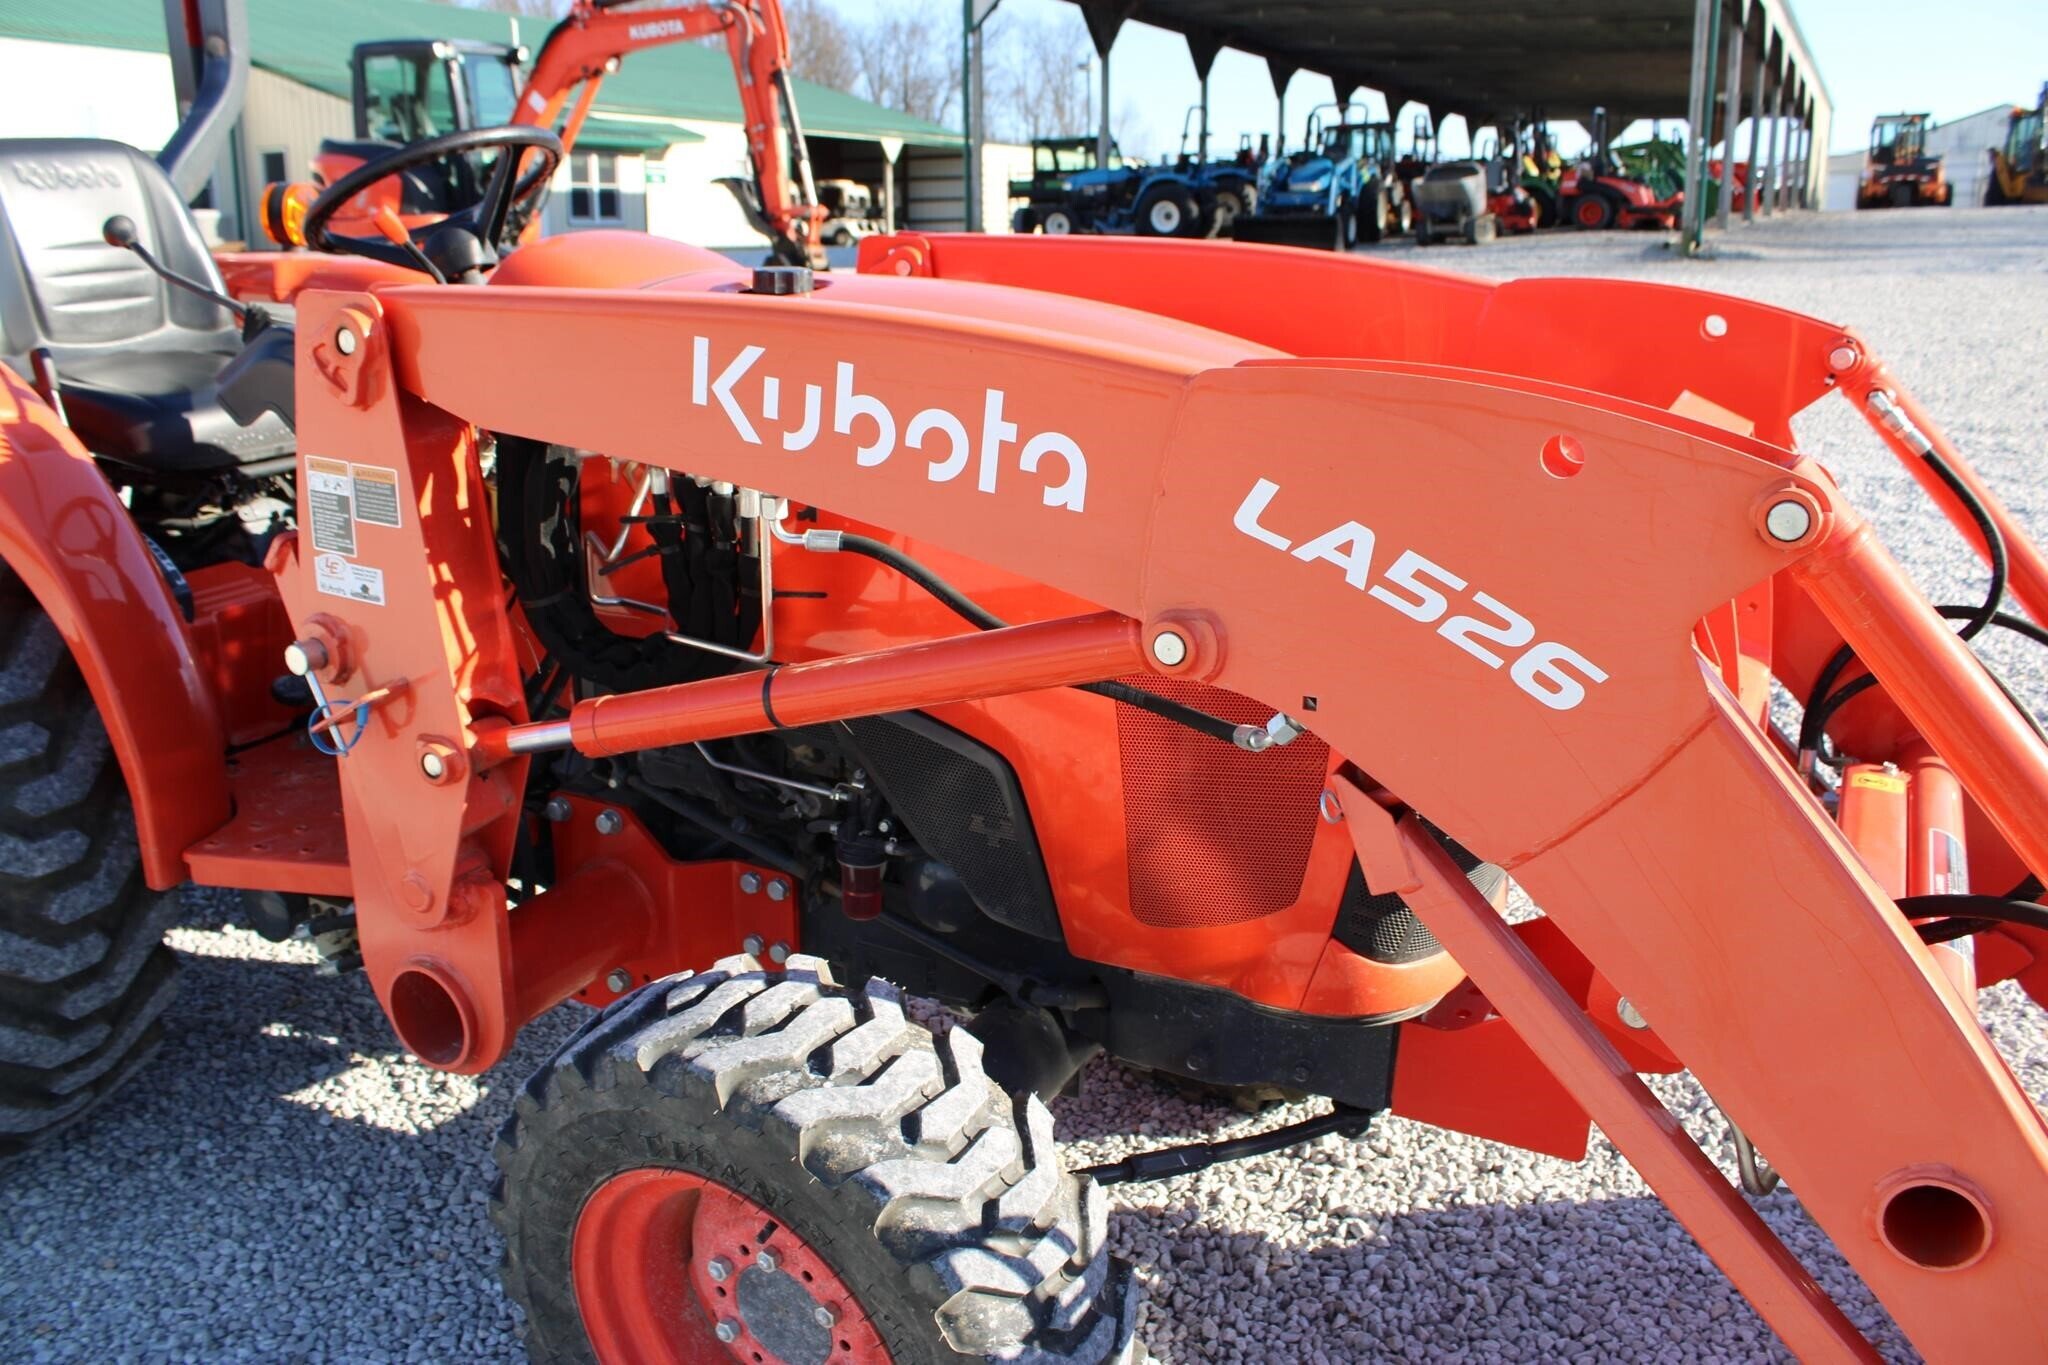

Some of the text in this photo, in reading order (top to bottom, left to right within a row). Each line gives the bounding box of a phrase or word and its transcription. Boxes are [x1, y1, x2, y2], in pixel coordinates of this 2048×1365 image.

[629, 19, 685, 40] KUBOTA
[692, 335, 1088, 512] Kubota
[1234, 477, 1609, 710] LA526
